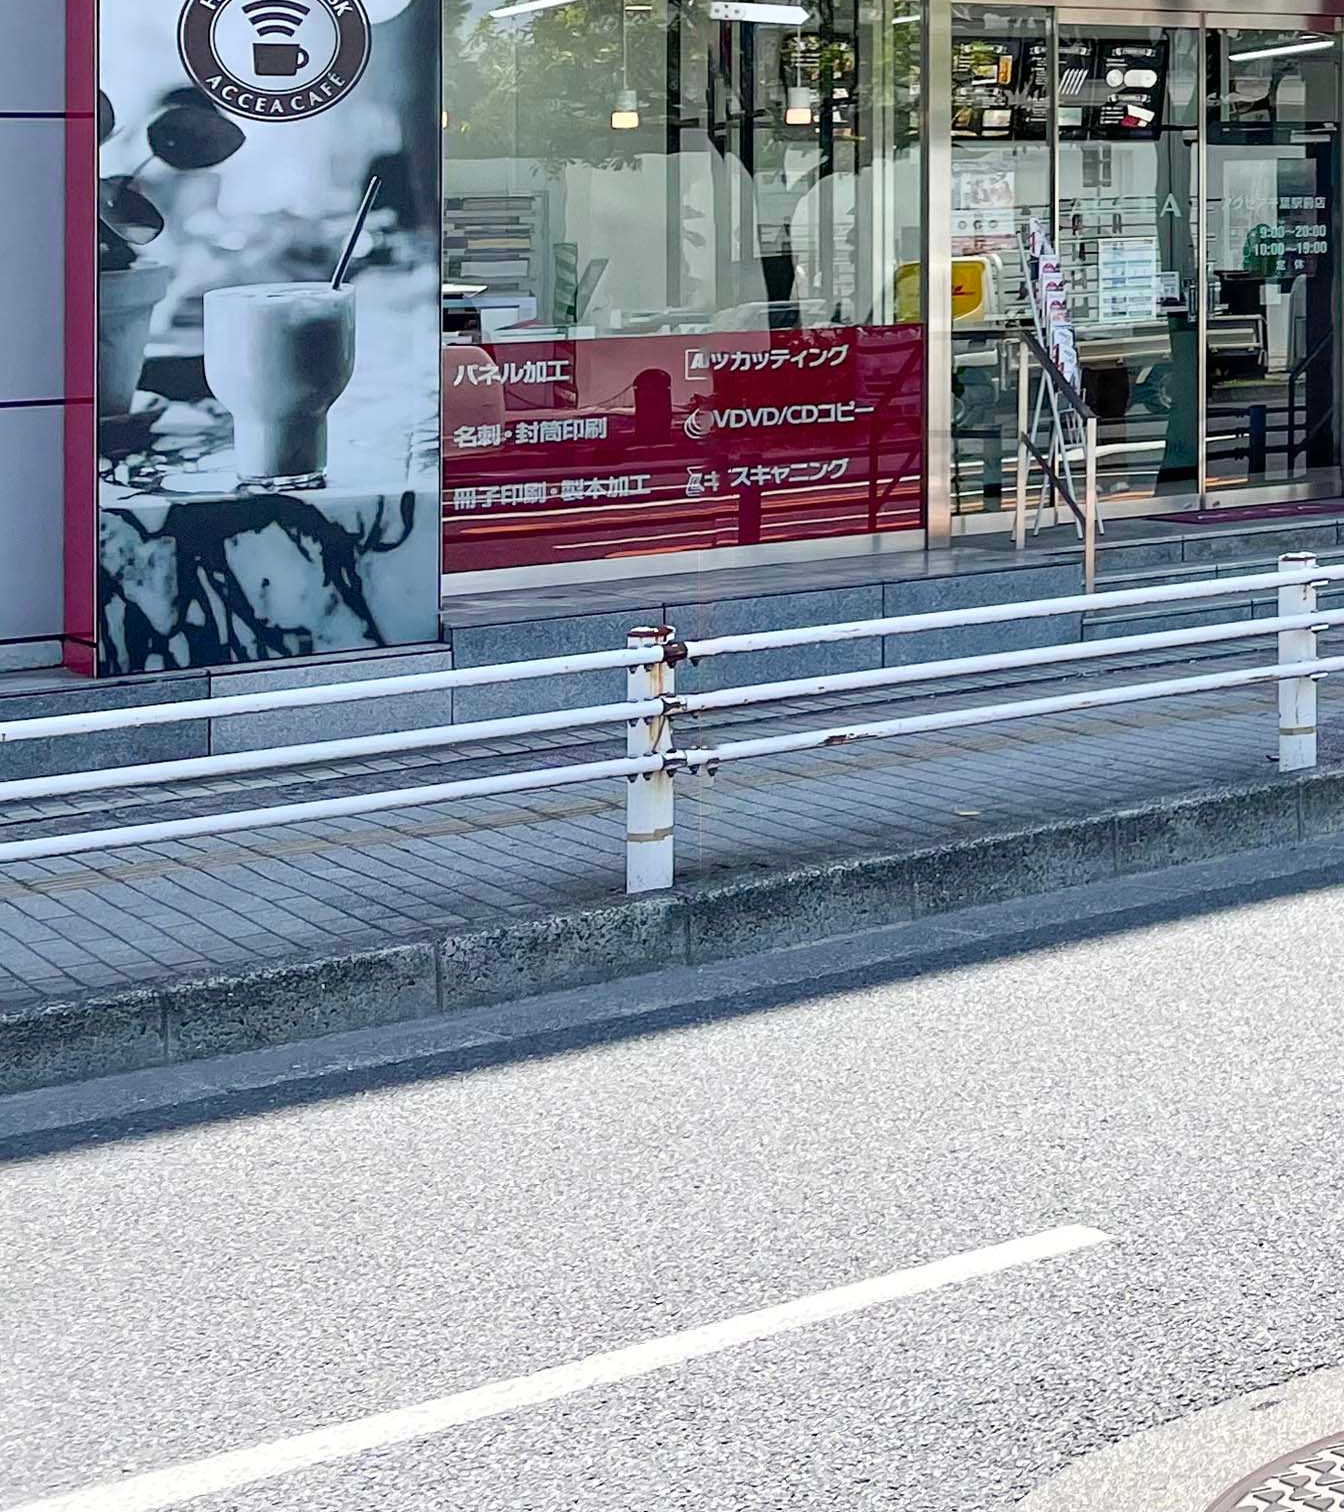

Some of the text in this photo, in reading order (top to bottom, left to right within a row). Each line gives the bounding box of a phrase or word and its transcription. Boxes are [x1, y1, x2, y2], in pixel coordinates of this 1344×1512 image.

[205, 74, 284, 114] ACCEA
[453, 360, 570, 387] パネル加工
[453, 417, 608, 448] 名刺・封筒印刷
[453, 473, 651, 511] 冊子印刷・製本加工
